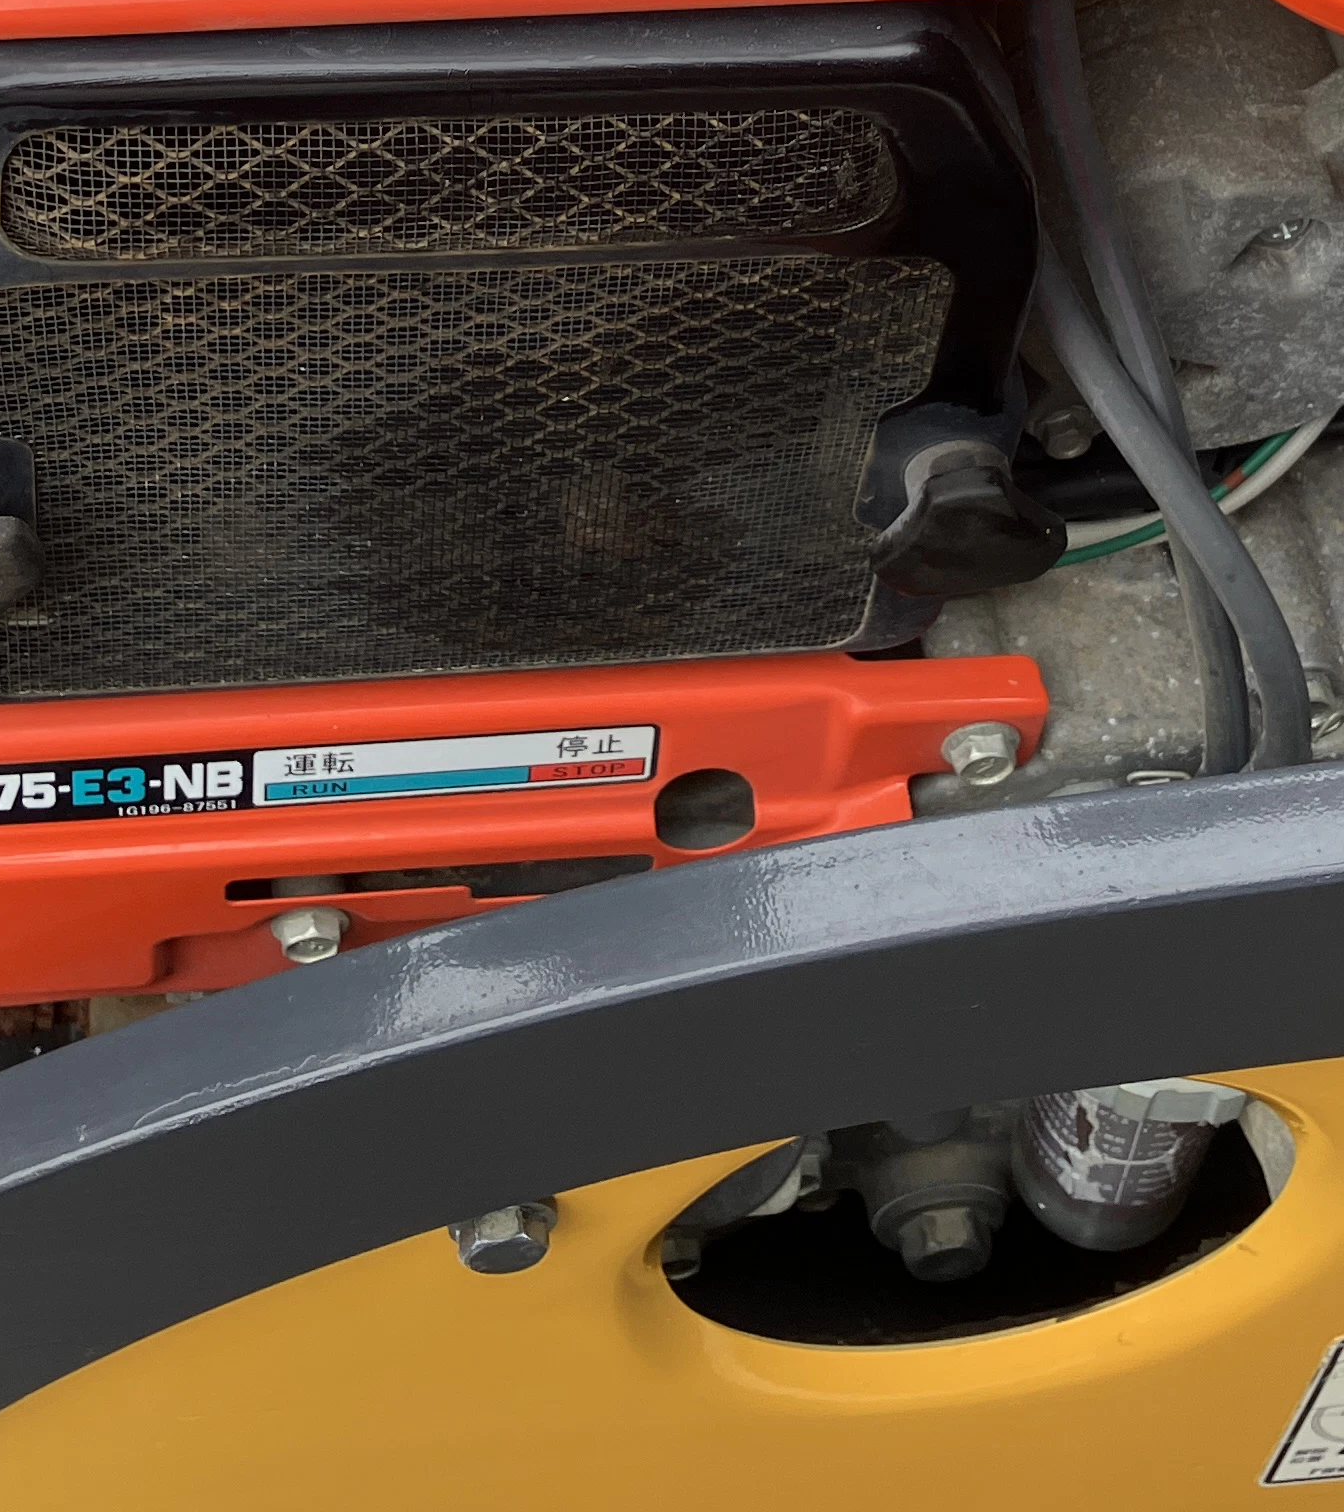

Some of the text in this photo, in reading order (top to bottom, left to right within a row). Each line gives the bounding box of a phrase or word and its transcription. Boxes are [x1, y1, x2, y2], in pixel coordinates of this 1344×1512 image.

[556, 736, 623, 759] 停止
[283, 752, 356, 777] 運転
[552, 762, 623, 779] STOP
[291, 782, 349, 797] RUN
[117, 798, 237, 816] 1G196-87551
